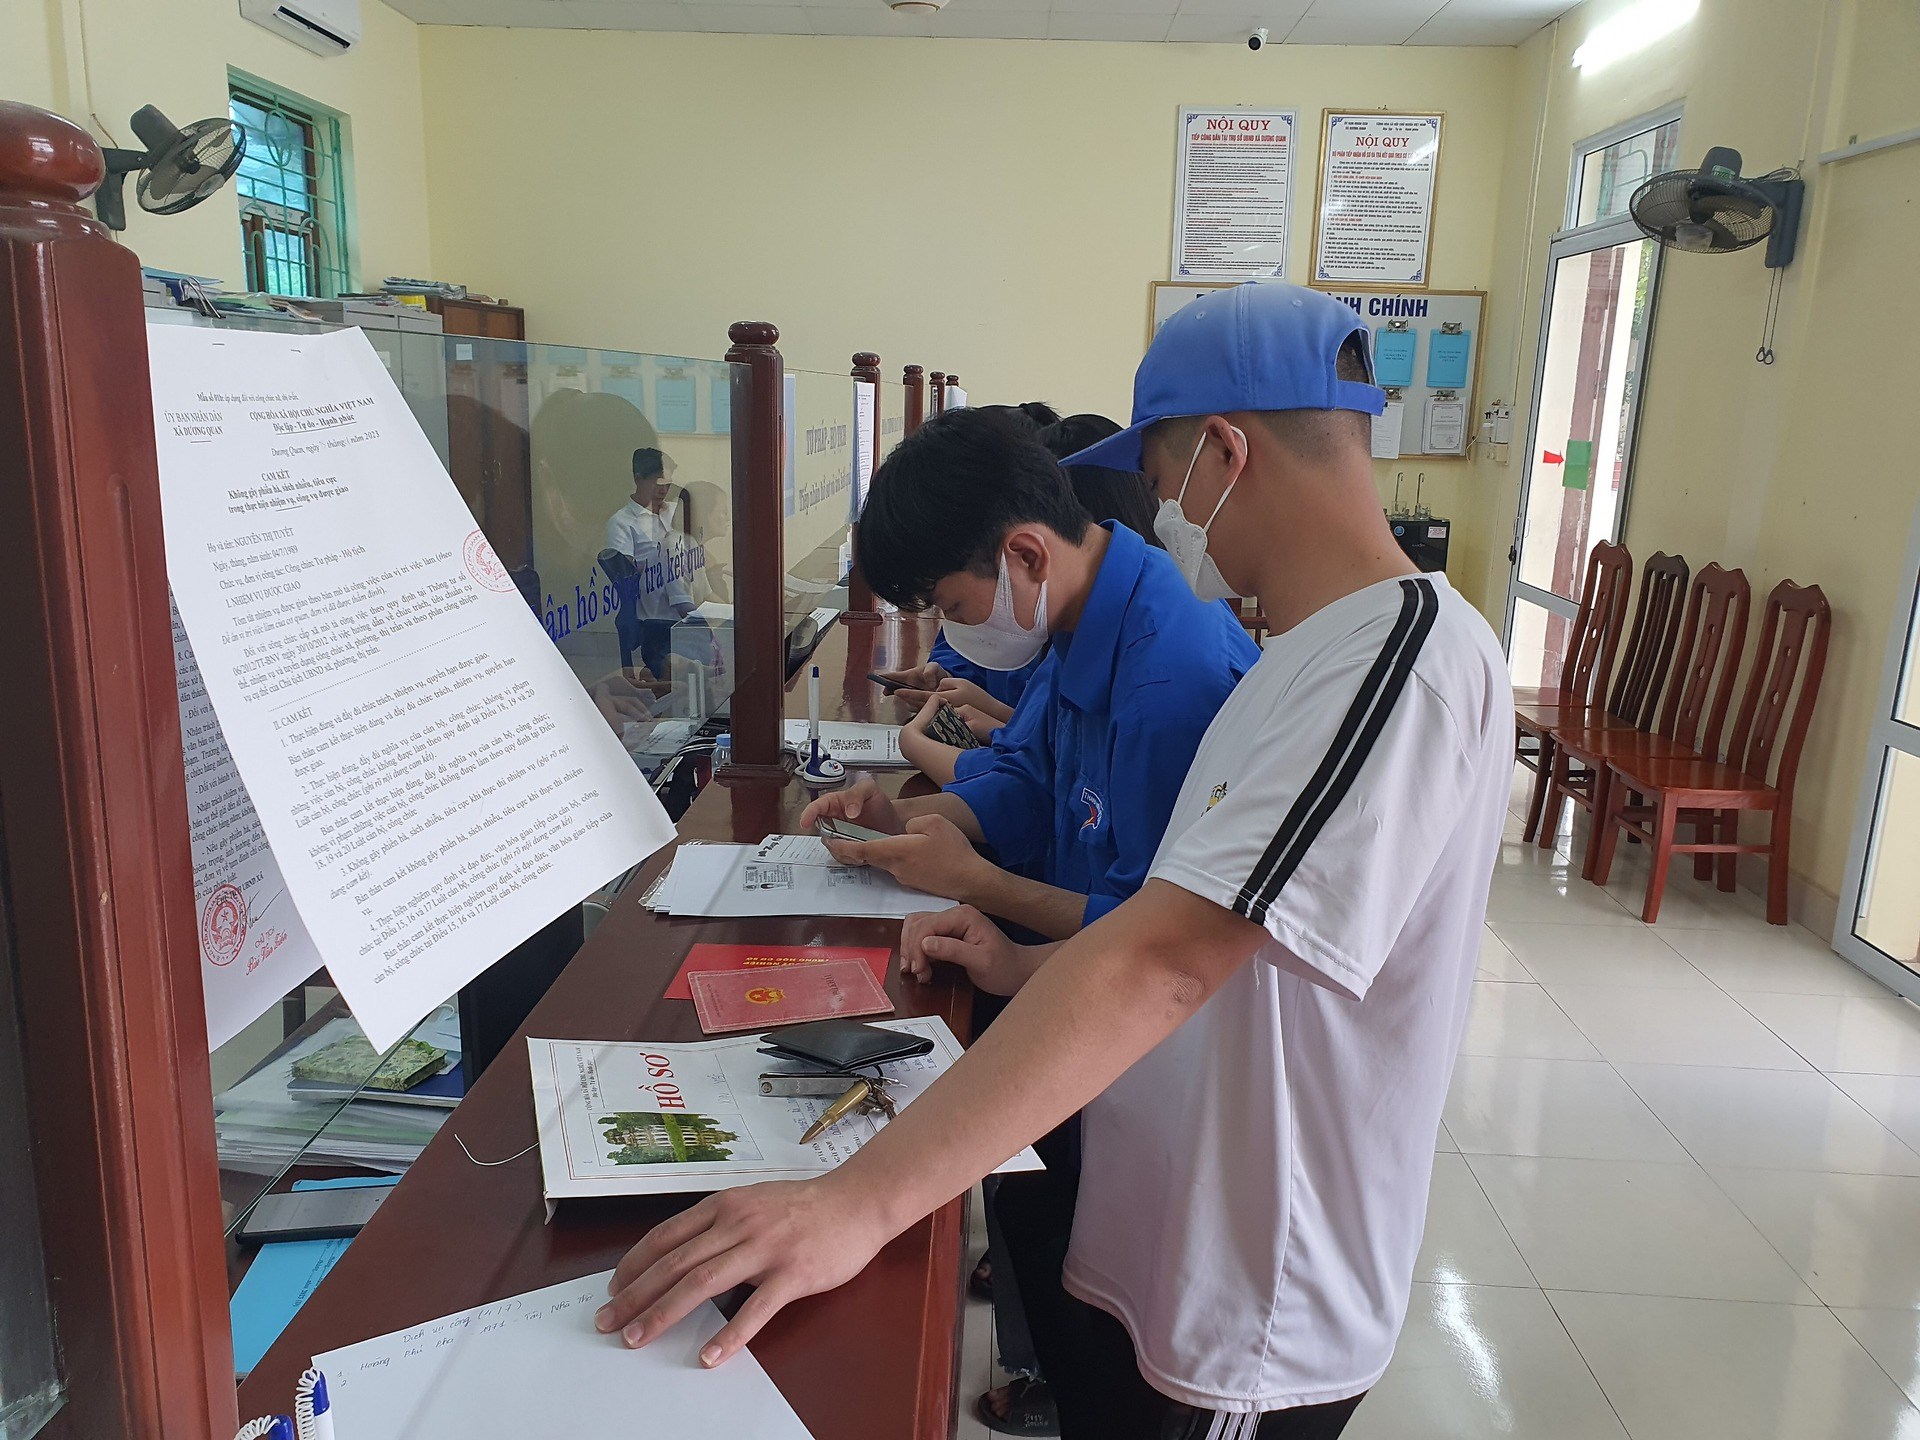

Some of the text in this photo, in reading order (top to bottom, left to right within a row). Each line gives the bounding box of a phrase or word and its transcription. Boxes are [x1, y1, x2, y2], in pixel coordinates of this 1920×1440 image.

[1206, 116, 1271, 133] NỘI QUY
[1355, 134, 1410, 149] NỘI QUY
[1368, 293, 1428, 317] CHÍNH
[164, 410, 223, 423] ỦY BAN NHÂN DÂN
[249, 397, 374, 422] CỘNG HÒA XÃ HỘI CHỦ NGHĨA VIỆT NAM
[173, 425, 223, 437] XÃ DƯƠNG QUAN
[261, 469, 290, 481] CAM KẾT
[576, 566, 598, 630] hồ
[645, 542, 664, 594] trả
[666, 535, 684, 584] kết
[687, 526, 706, 582] quả
[638, 1052, 686, 1110] HỒ SƠ
